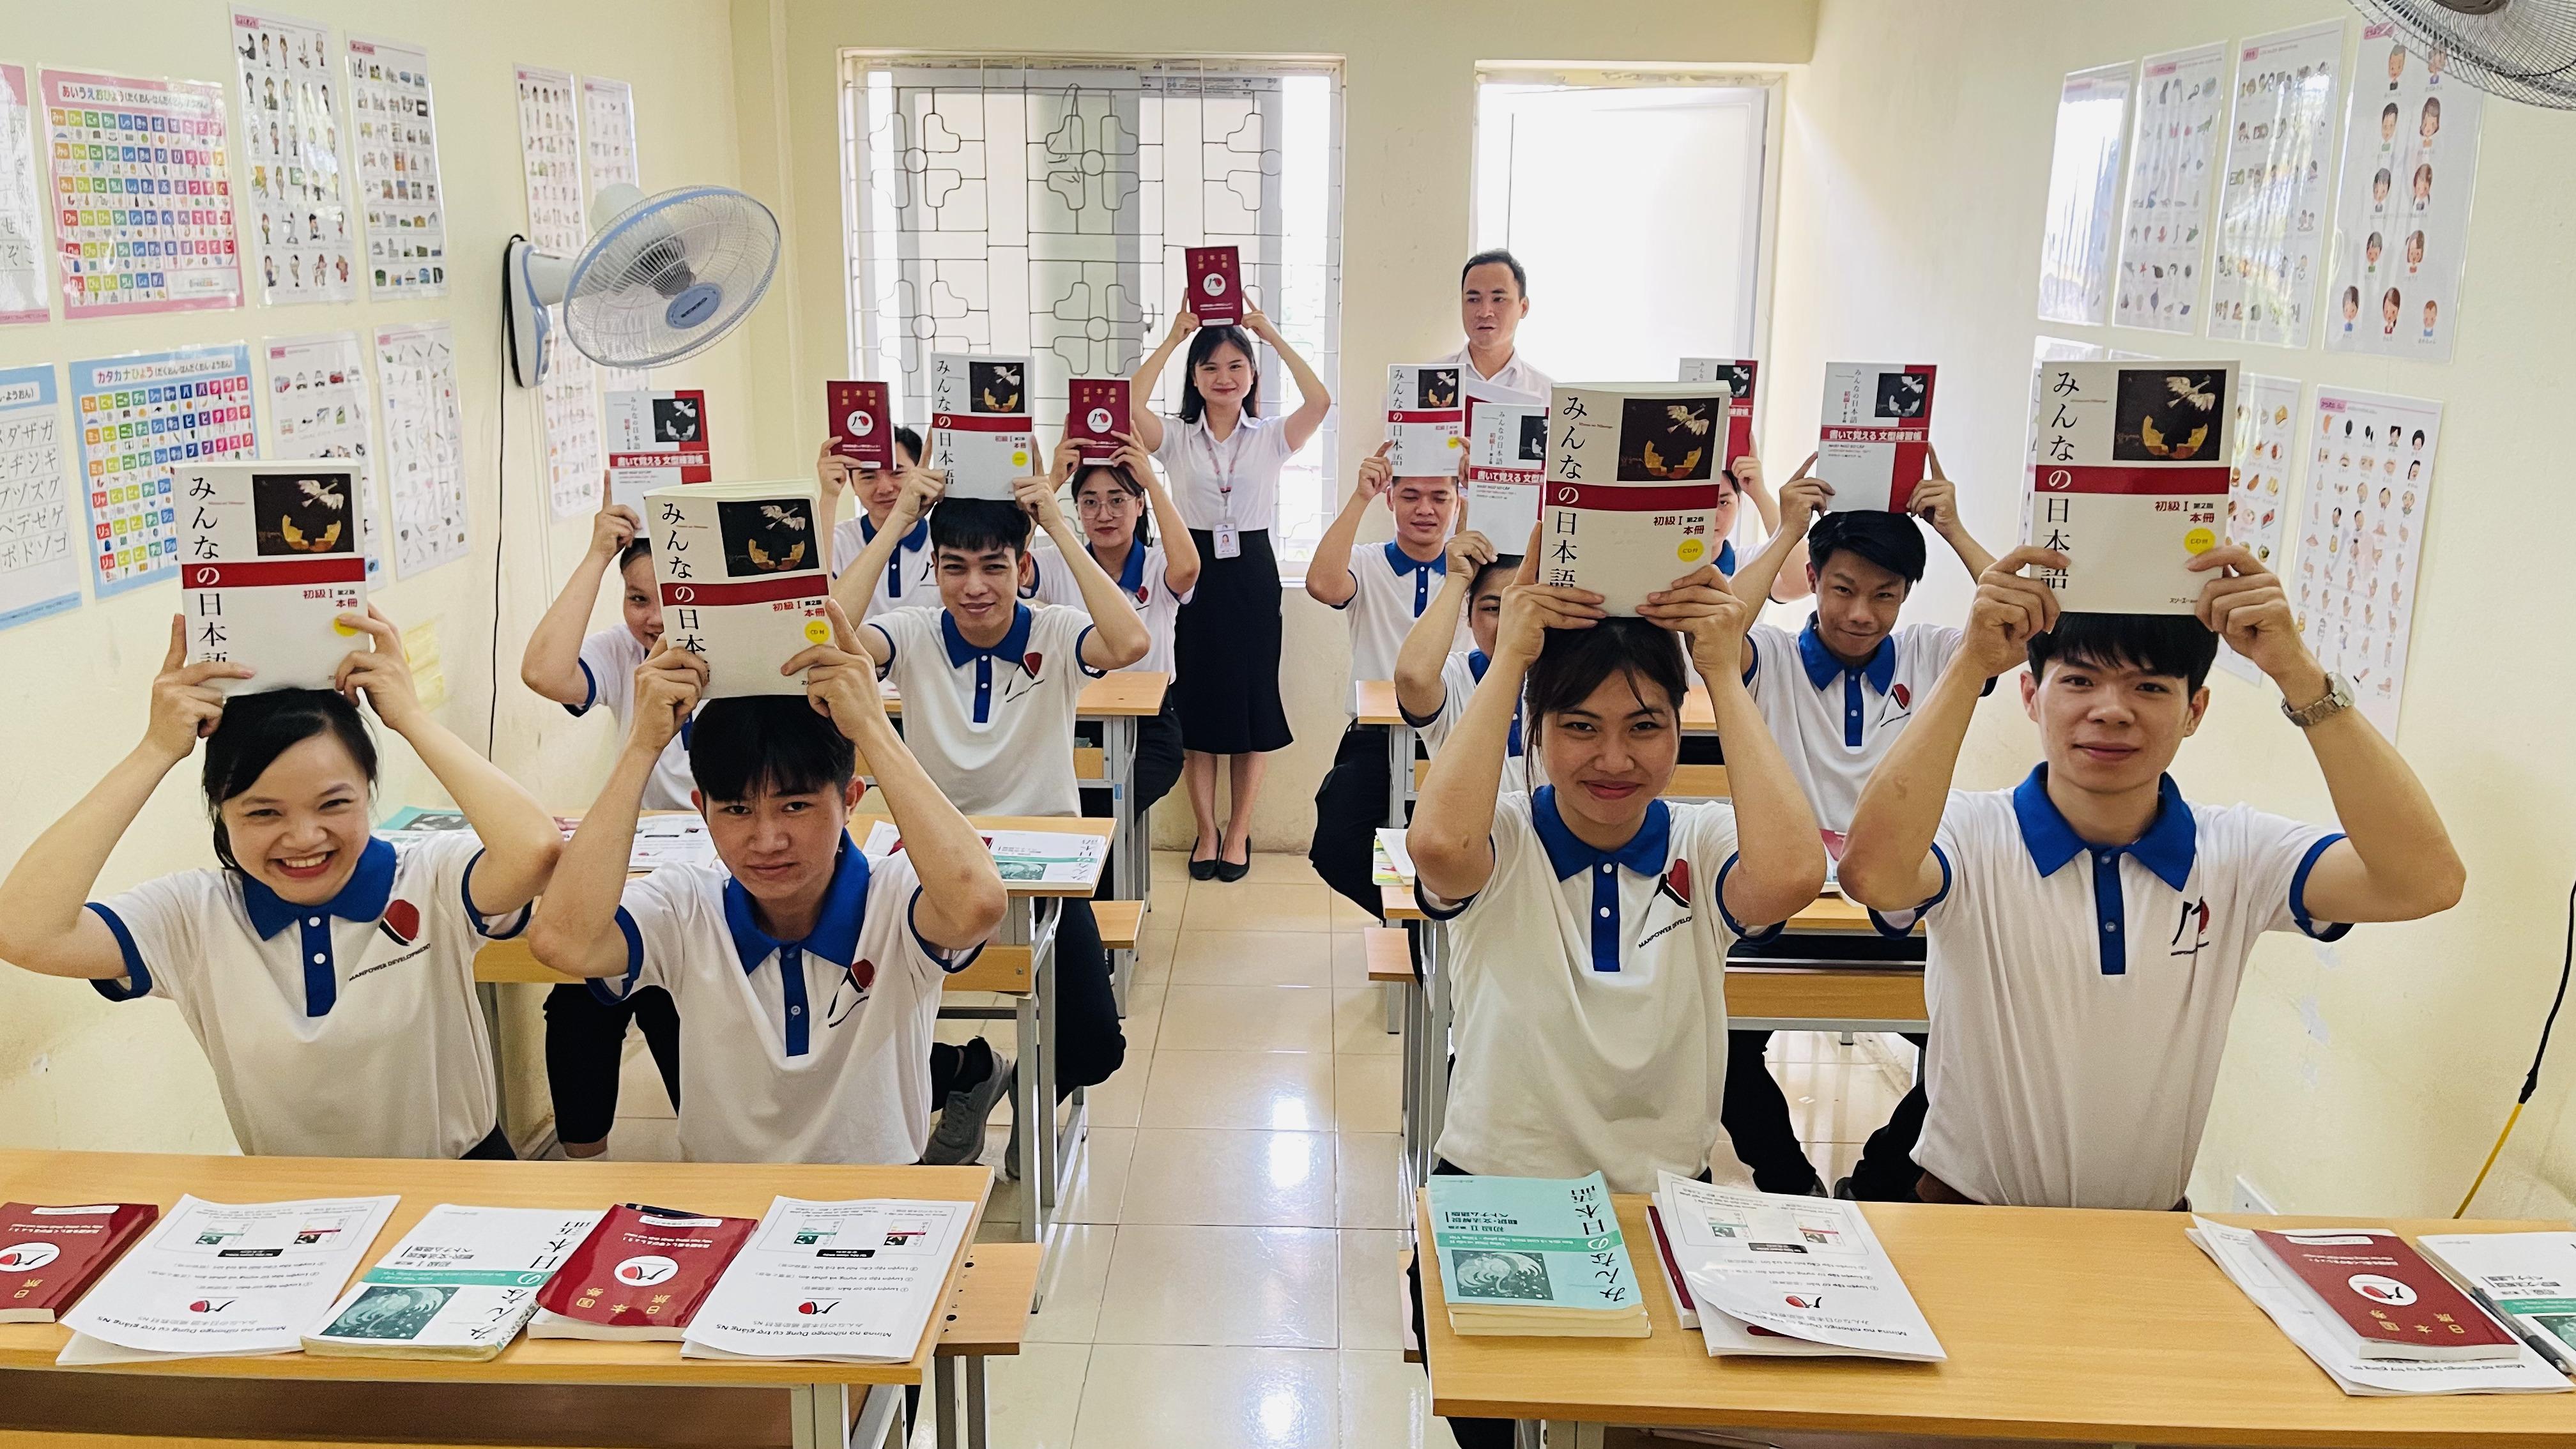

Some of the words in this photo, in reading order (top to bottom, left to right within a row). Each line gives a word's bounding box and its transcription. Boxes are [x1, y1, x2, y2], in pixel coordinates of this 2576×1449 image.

[1390, 369, 1404, 466] みんなの日本語
[1850, 369, 1862, 424] みんなの日本語
[1549, 396, 1588, 587] みんなの日本語
[2189, 512, 2215, 523] 本冊
[1683, 526, 1705, 535] 本冊
[335, 599, 358, 608] 本冊
[804, 608, 825, 618] 本冊
[1570, 1185, 1625, 1302] みんなの日本語
[470, 1220, 592, 1340] みんなの日本語
